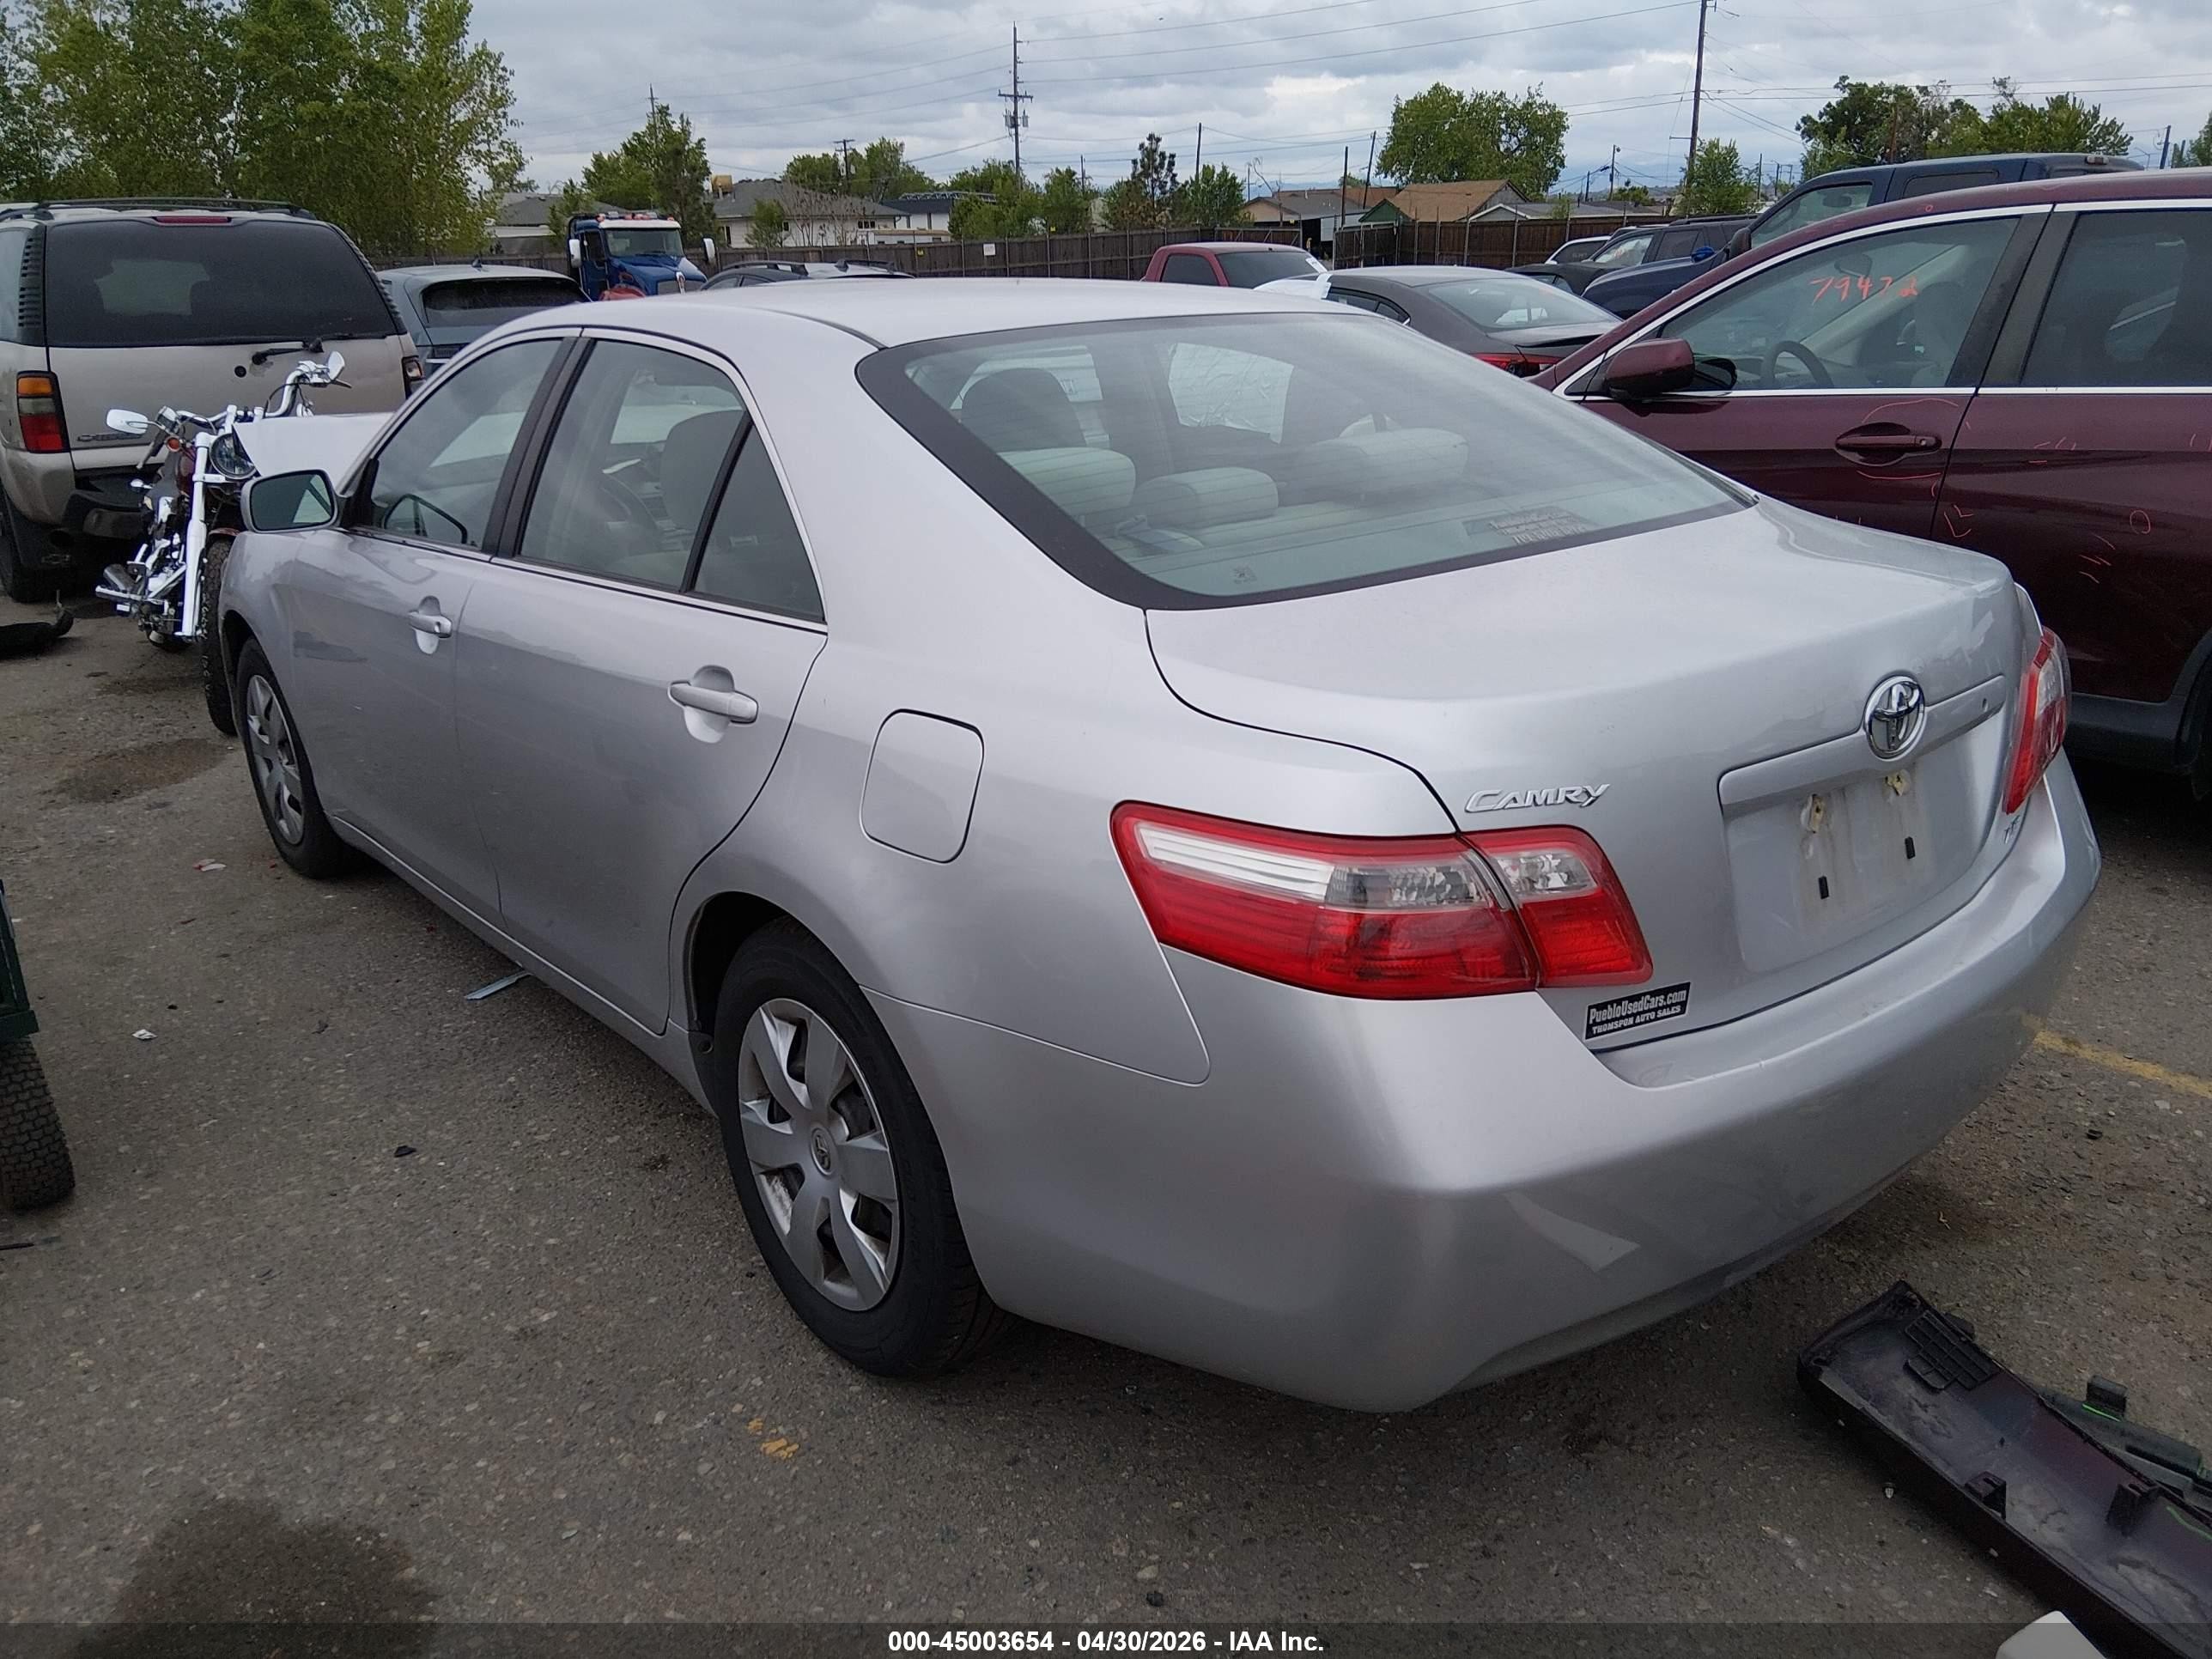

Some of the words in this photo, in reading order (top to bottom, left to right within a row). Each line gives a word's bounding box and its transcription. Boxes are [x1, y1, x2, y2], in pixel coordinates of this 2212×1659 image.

[1465, 783, 1611, 812] CAMRY
[1589, 990, 1687, 1024] PuebloUsedCars.com
[1635, 1012, 1656, 1024] AUTO
[1656, 1005, 1681, 1018] SALES
